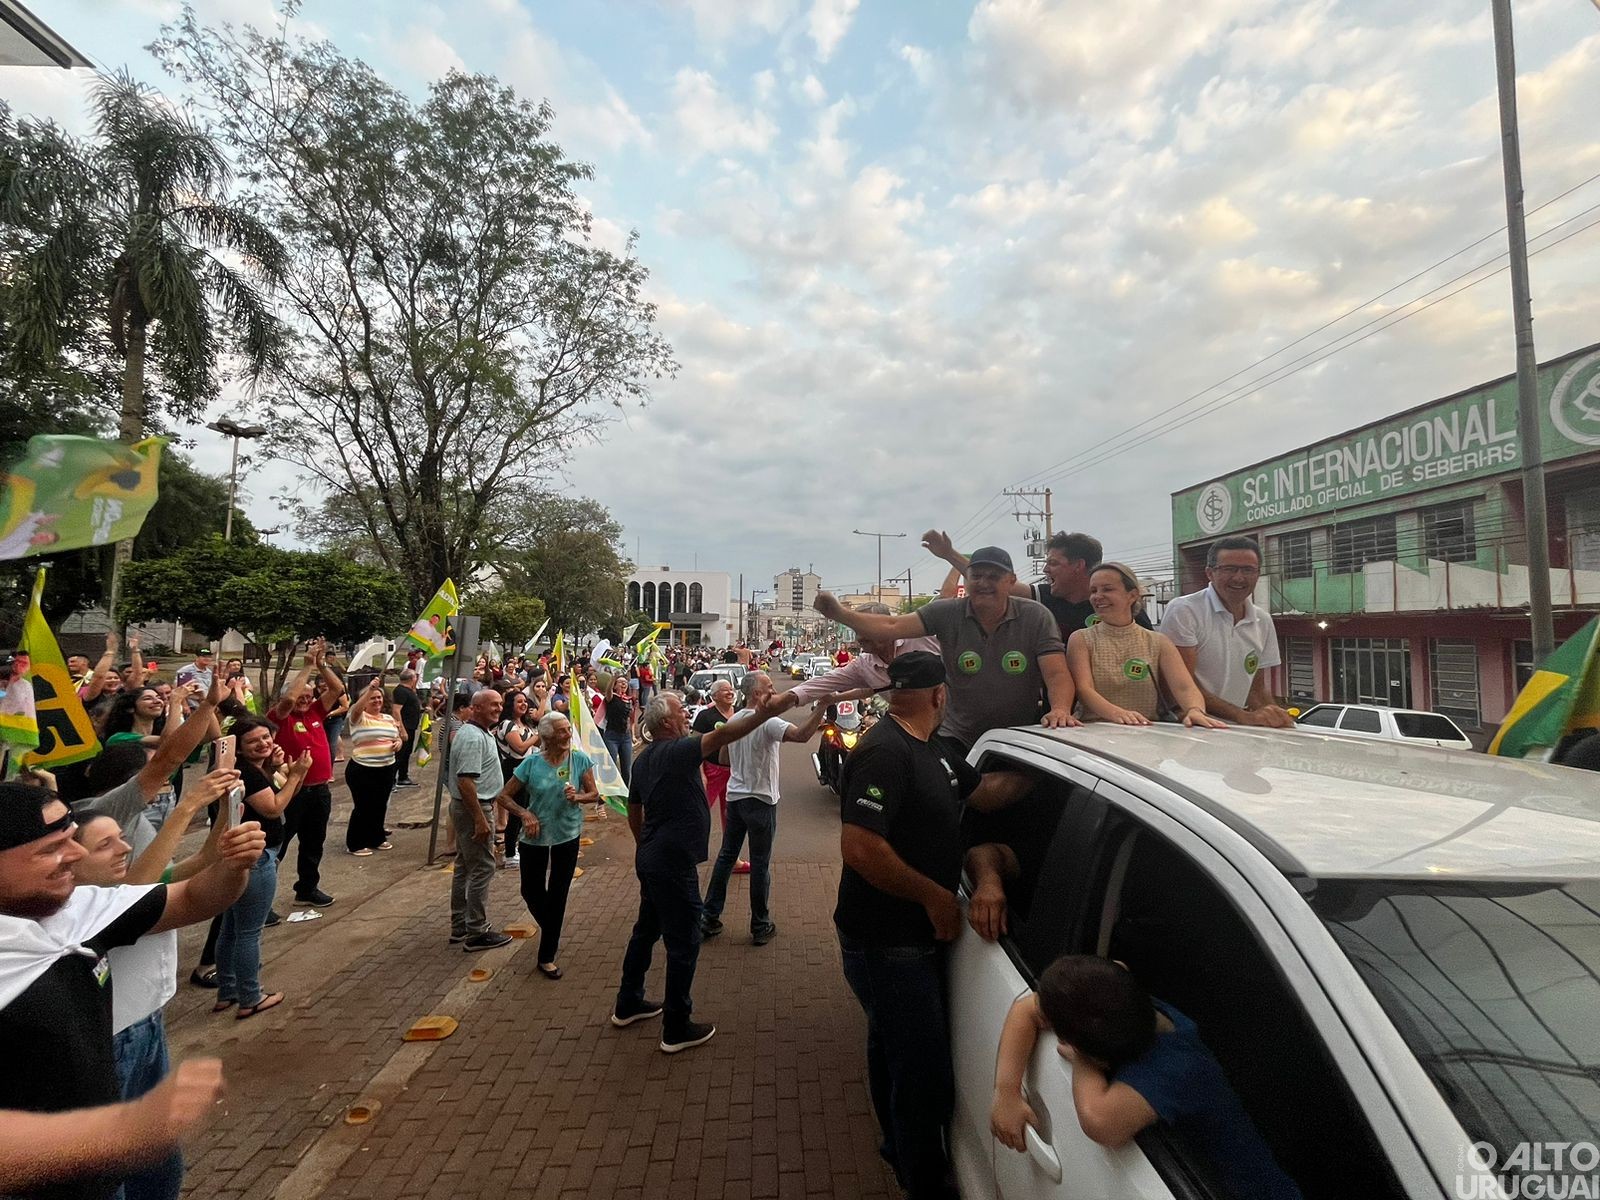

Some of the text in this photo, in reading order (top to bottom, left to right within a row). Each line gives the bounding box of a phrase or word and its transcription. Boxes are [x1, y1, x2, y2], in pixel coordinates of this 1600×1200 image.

[1274, 399, 1517, 500] INTERNACIONAL
[1247, 494, 1313, 522] CONSULADO
[1317, 480, 1373, 505] OFICIAL
[1380, 470, 1403, 492] DE
[1412, 443, 1517, 482] SEBERI-RS
[1010, 659, 1020, 668] 15
[1131, 665, 1142, 674] 15
[838, 702, 853, 714] 15
